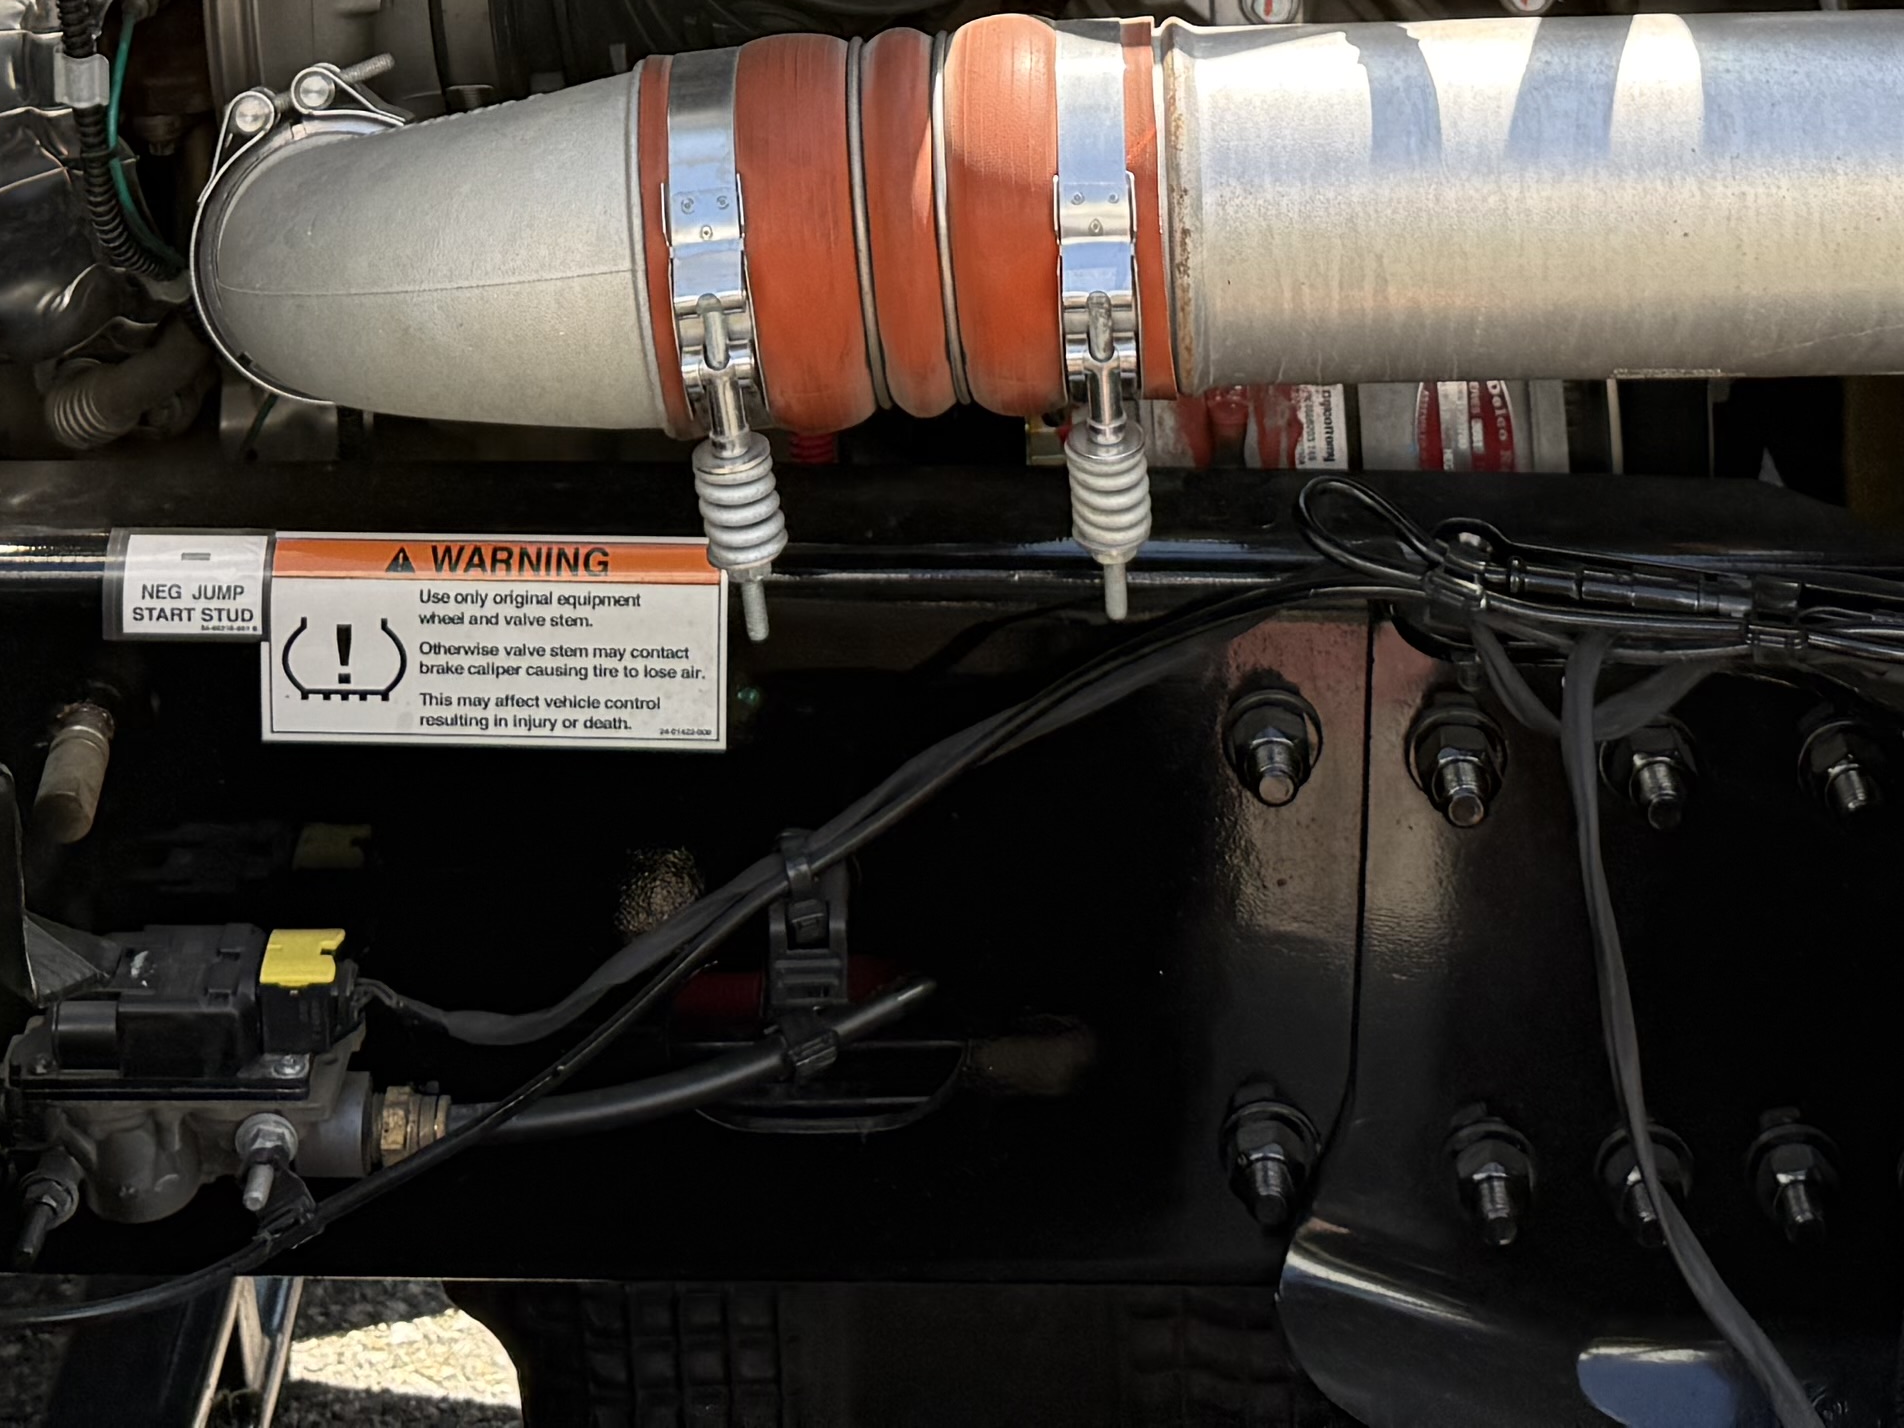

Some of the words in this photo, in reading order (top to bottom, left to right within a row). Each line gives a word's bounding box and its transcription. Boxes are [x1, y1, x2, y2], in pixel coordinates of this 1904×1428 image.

[431, 544, 610, 577] WARNING
[141, 583, 182, 600] NEG
[192, 584, 245, 601] JUMP
[419, 588, 450, 606] Use
[454, 590, 488, 608] only
[493, 590, 552, 609] original
[557, 593, 641, 610] equipment
[133, 607, 196, 622] START
[201, 607, 254, 622] STUD
[419, 612, 465, 625] wheel
[468, 612, 499, 626] and
[504, 613, 546, 626] valve
[550, 615, 593, 627] stem.
[419, 641, 499, 656] Otherwise
[504, 643, 546, 657] valve
[550, 645, 588, 658] stem
[593, 648, 626, 661] may
[630, 646, 689, 660] contact
[419, 661, 465, 675] brake
[467, 662, 522, 679] caliper
[526, 664, 588, 680] causing
[593, 664, 619, 678] tire
[623, 665, 639, 678] to
[643, 665, 676, 679] lose
[681, 666, 706, 680] air.
[419, 693, 453, 707] This
[457, 697, 490, 711] may
[495, 694, 540, 708] affect
[544, 695, 600, 709] vehicle
[604, 696, 660, 709] control
[419, 714, 489, 730] resulting
[494, 715, 509, 728] in
[513, 716, 557, 732] injury
[561, 718, 579, 729] or
[583, 717, 632, 730] death.
